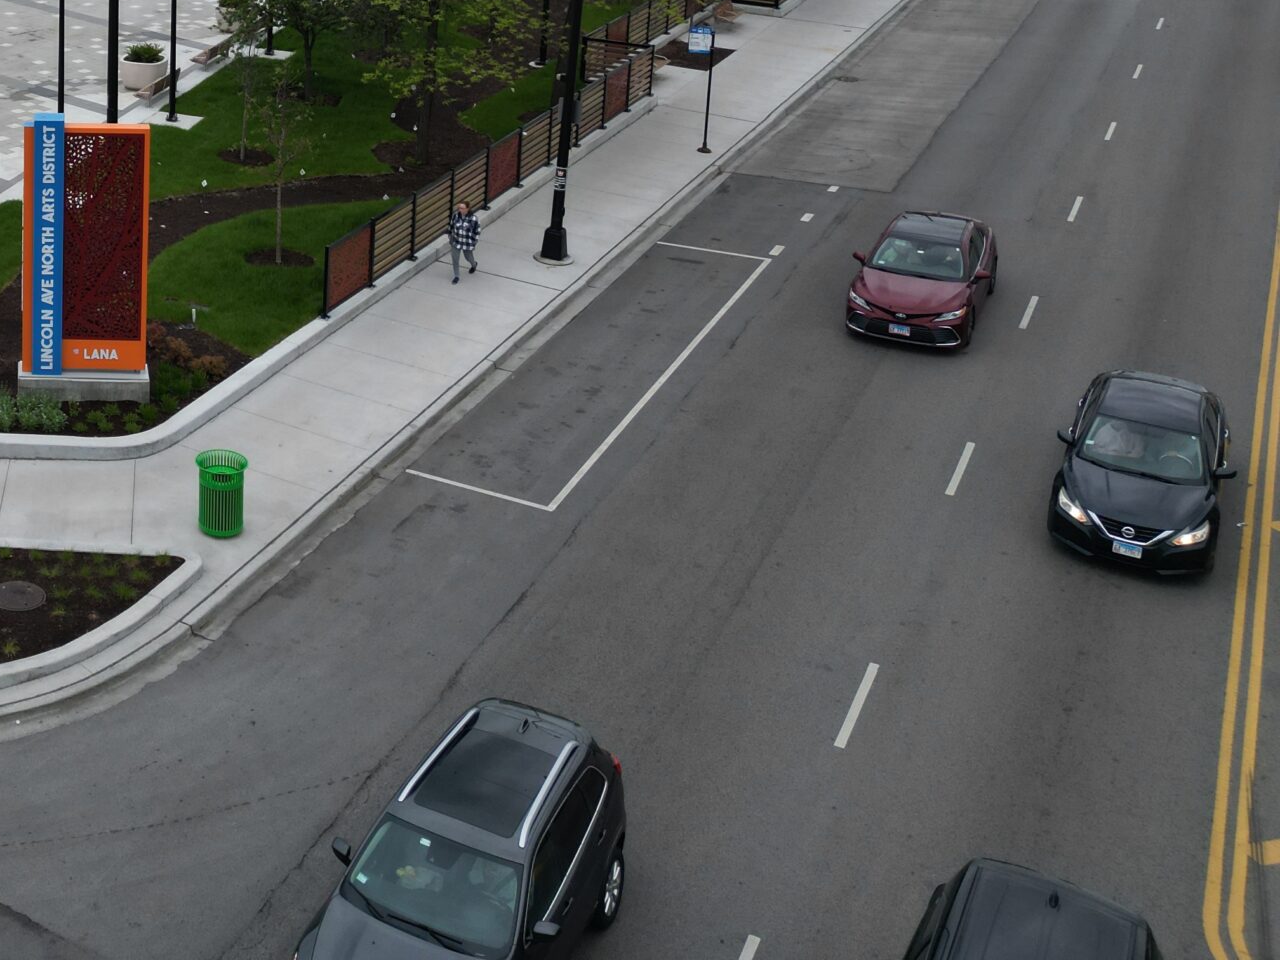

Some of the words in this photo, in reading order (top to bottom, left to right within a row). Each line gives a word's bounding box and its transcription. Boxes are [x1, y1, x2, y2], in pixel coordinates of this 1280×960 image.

[42, 125, 56, 185] DISTRICT
[41, 188, 55, 224] ARTS
[41, 226, 55, 276] NORTH
[40, 279, 55, 306] AVE
[40, 309, 55, 371] LINCOLN
[83, 349, 119, 360] LANA
